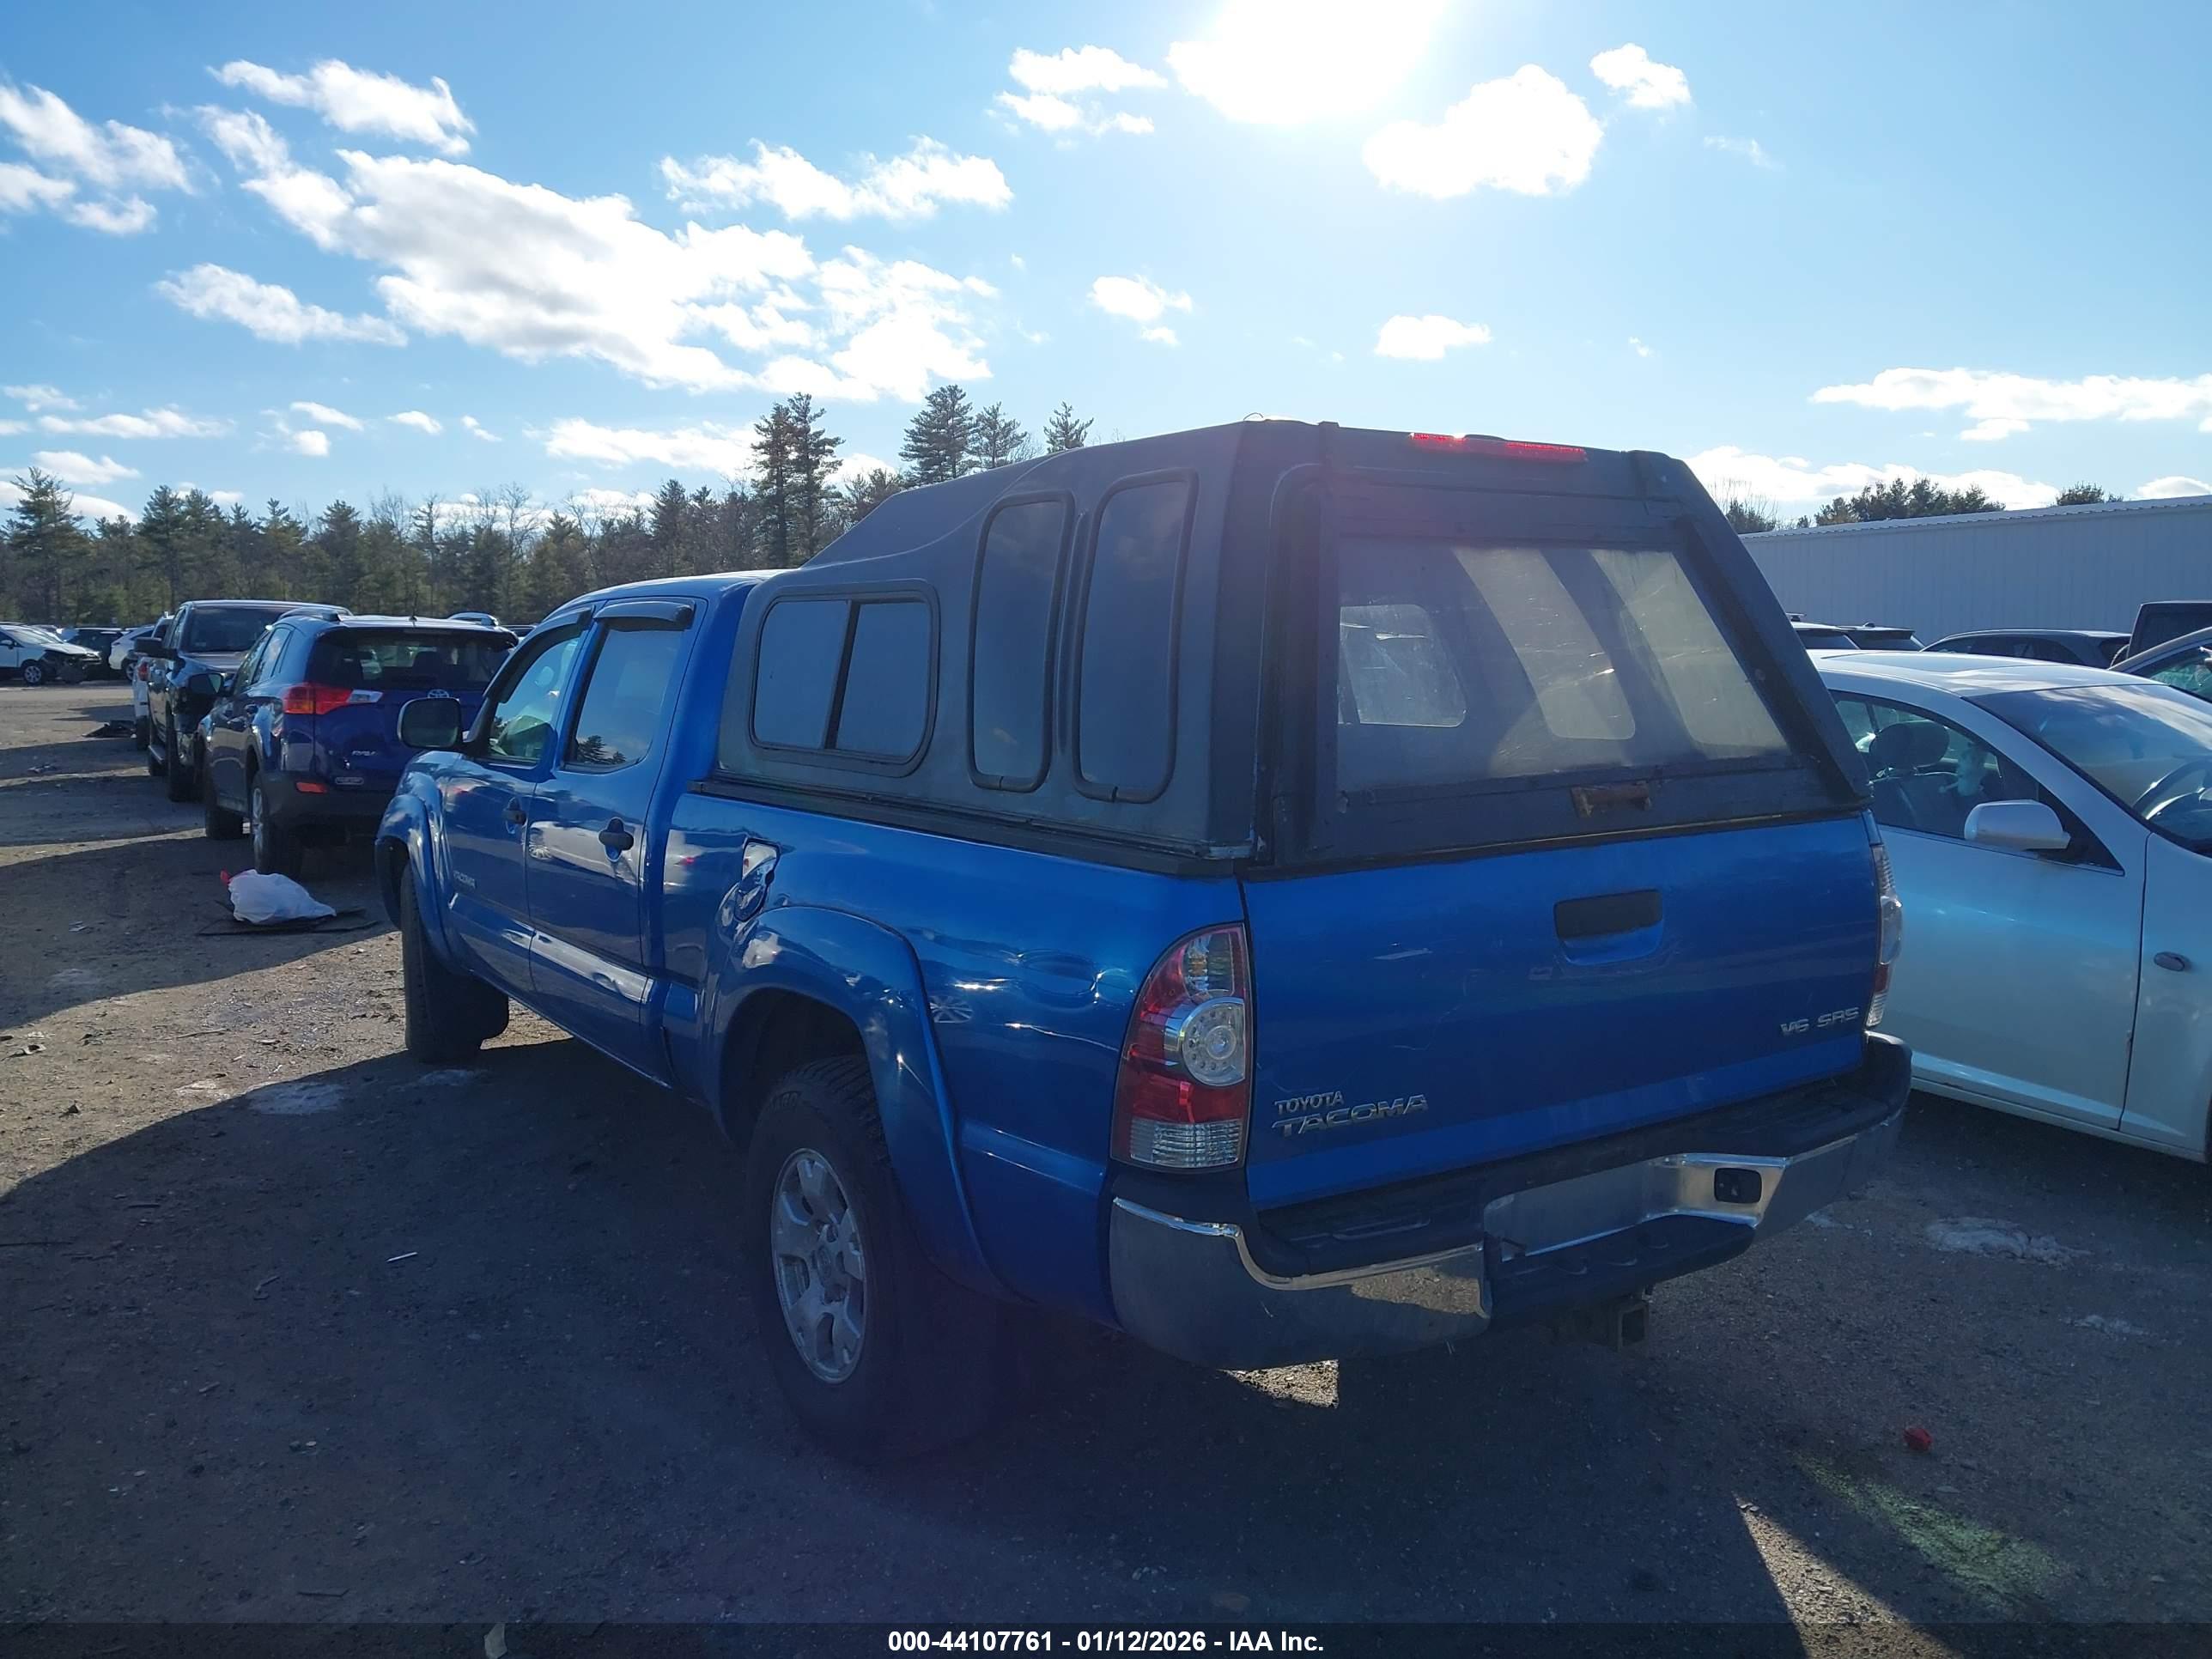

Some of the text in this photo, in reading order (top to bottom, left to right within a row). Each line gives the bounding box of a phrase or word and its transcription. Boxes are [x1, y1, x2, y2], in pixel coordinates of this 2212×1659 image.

[1780, 1018, 1809, 1035] V6
[1274, 1091, 1345, 1115] TOYOTA
[1271, 1094, 1428, 1137] TACOMA
